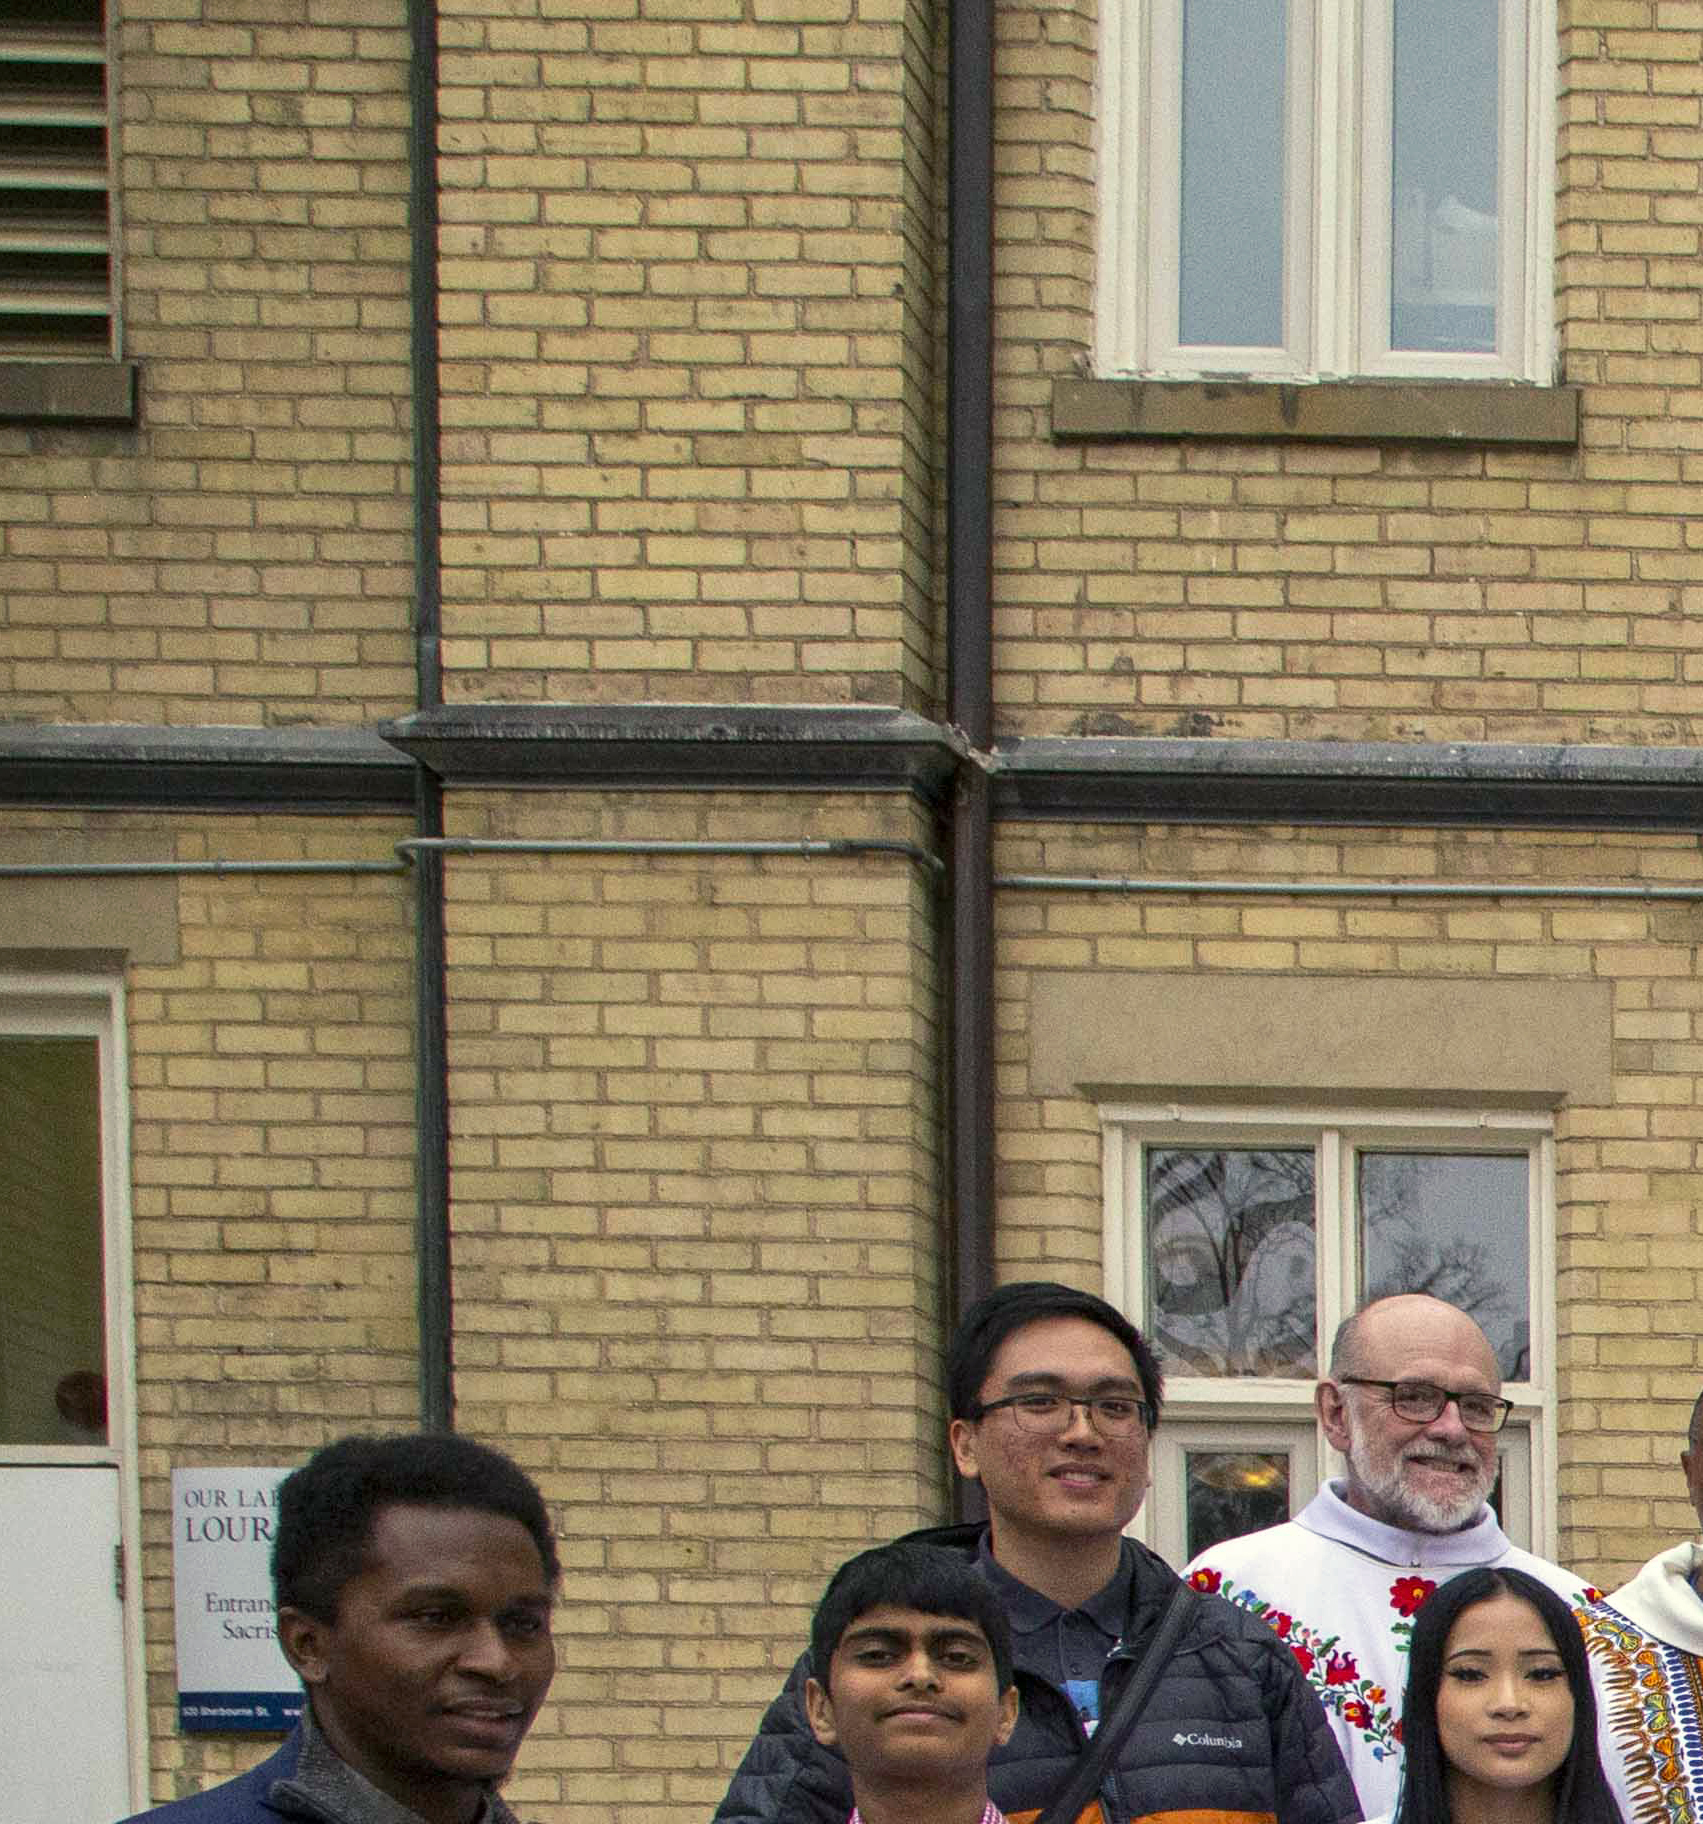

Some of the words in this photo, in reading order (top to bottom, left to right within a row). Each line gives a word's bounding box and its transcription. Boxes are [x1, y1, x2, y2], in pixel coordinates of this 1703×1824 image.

[185, 1489, 228, 1507] OUR
[186, 1516, 277, 1542] LOUR
[223, 1620, 281, 1640] Sacris
[1187, 1733, 1242, 1749] Columbia
